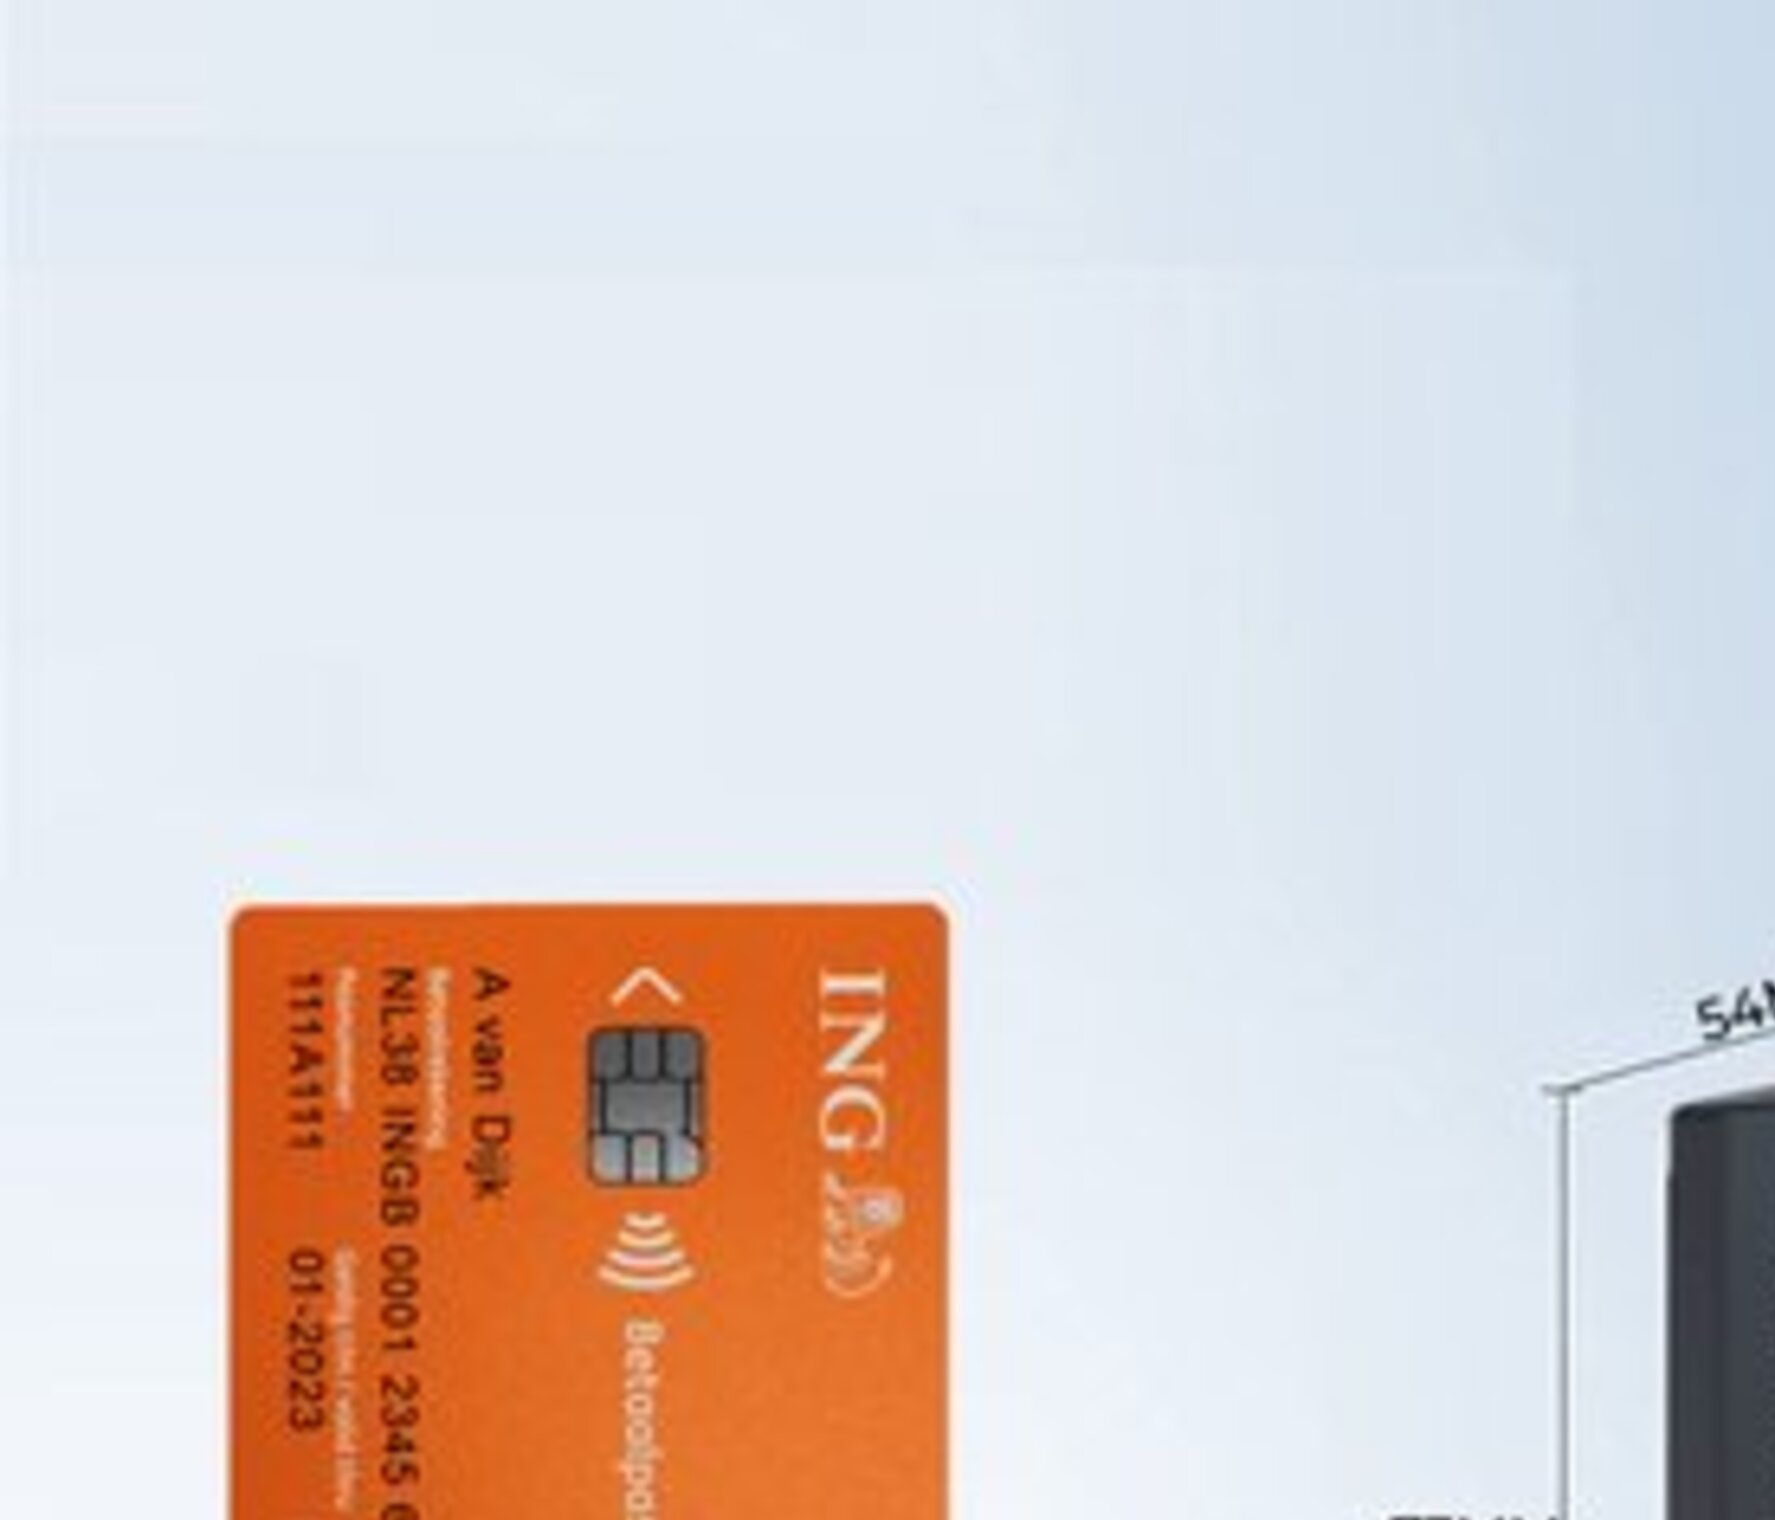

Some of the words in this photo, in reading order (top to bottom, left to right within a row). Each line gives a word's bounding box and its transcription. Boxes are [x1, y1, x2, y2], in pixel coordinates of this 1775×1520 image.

[379, 968, 419, 1086] NL38
[472, 968, 511, 1001] A
[286, 973, 325, 1150] 111A111
[471, 1016, 503, 1094] van
[817, 968, 886, 1154] ING
[379, 1105, 419, 1228] INGB
[462, 1115, 511, 1202] Dijk
[286, 1248, 325, 1433] 01-2023
[379, 1244, 419, 1352] 0001
[379, 1374, 419, 1486] 2345
